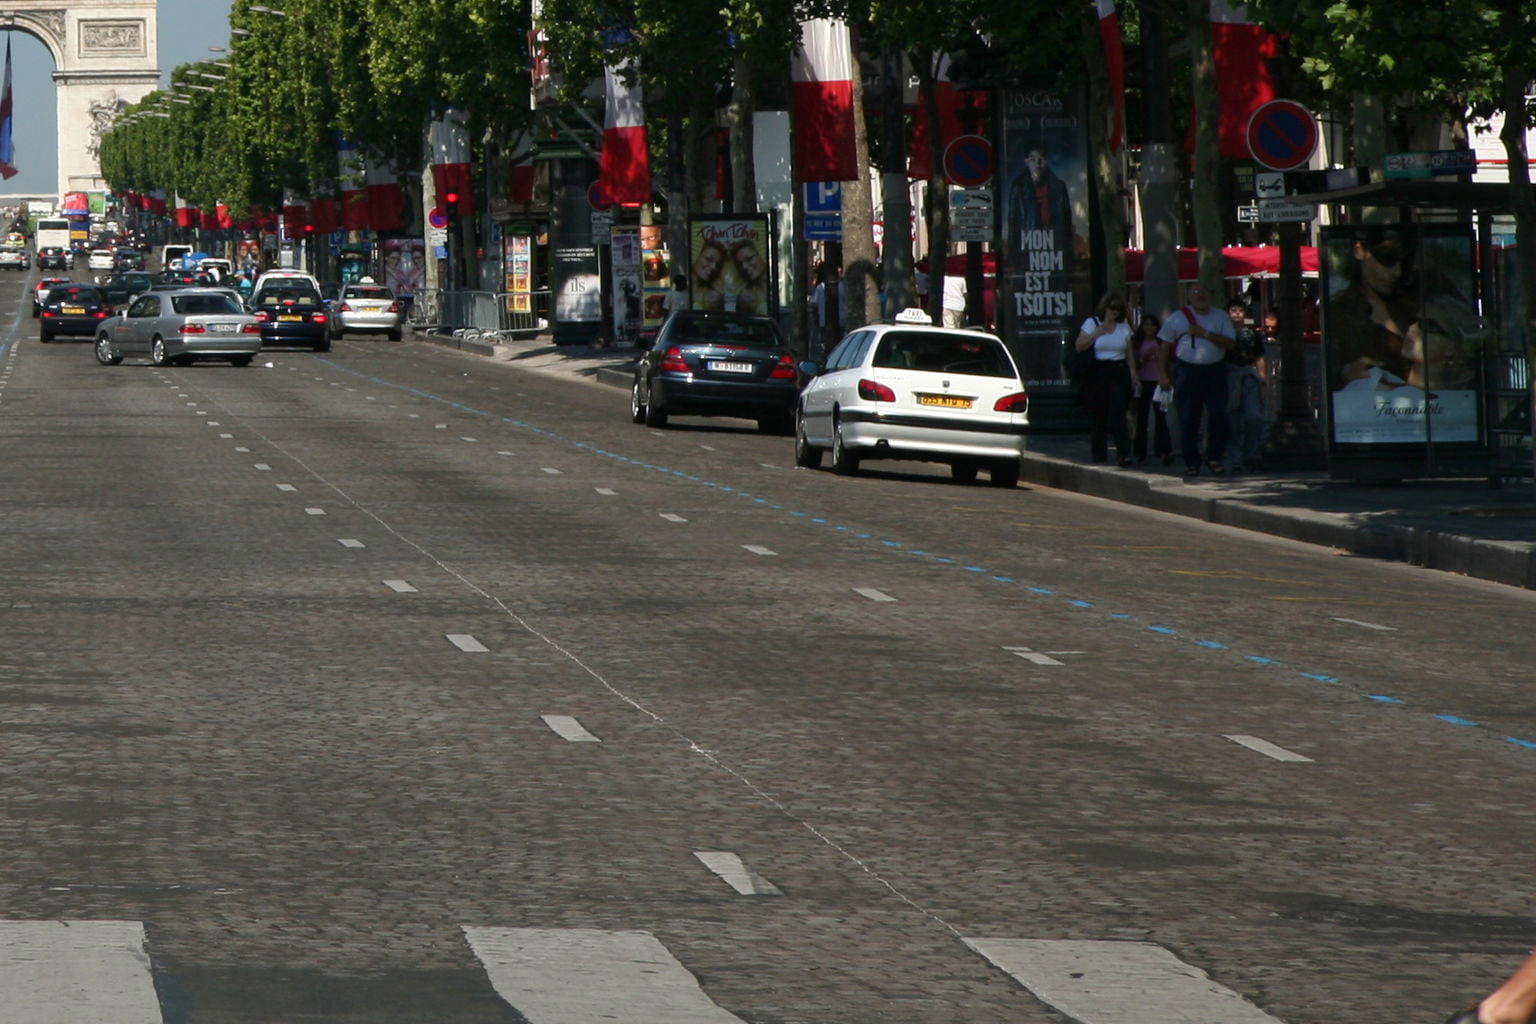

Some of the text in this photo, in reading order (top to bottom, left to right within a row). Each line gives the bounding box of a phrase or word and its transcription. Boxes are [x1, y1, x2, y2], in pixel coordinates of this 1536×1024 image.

[818, 180, 841, 204] P
[1020, 229, 1054, 251] MON
[1029, 250, 1064, 271] NOM
[570, 277, 586, 292] ils
[1025, 271, 1051, 292] EST
[1014, 291, 1073, 317] TSOTSI
